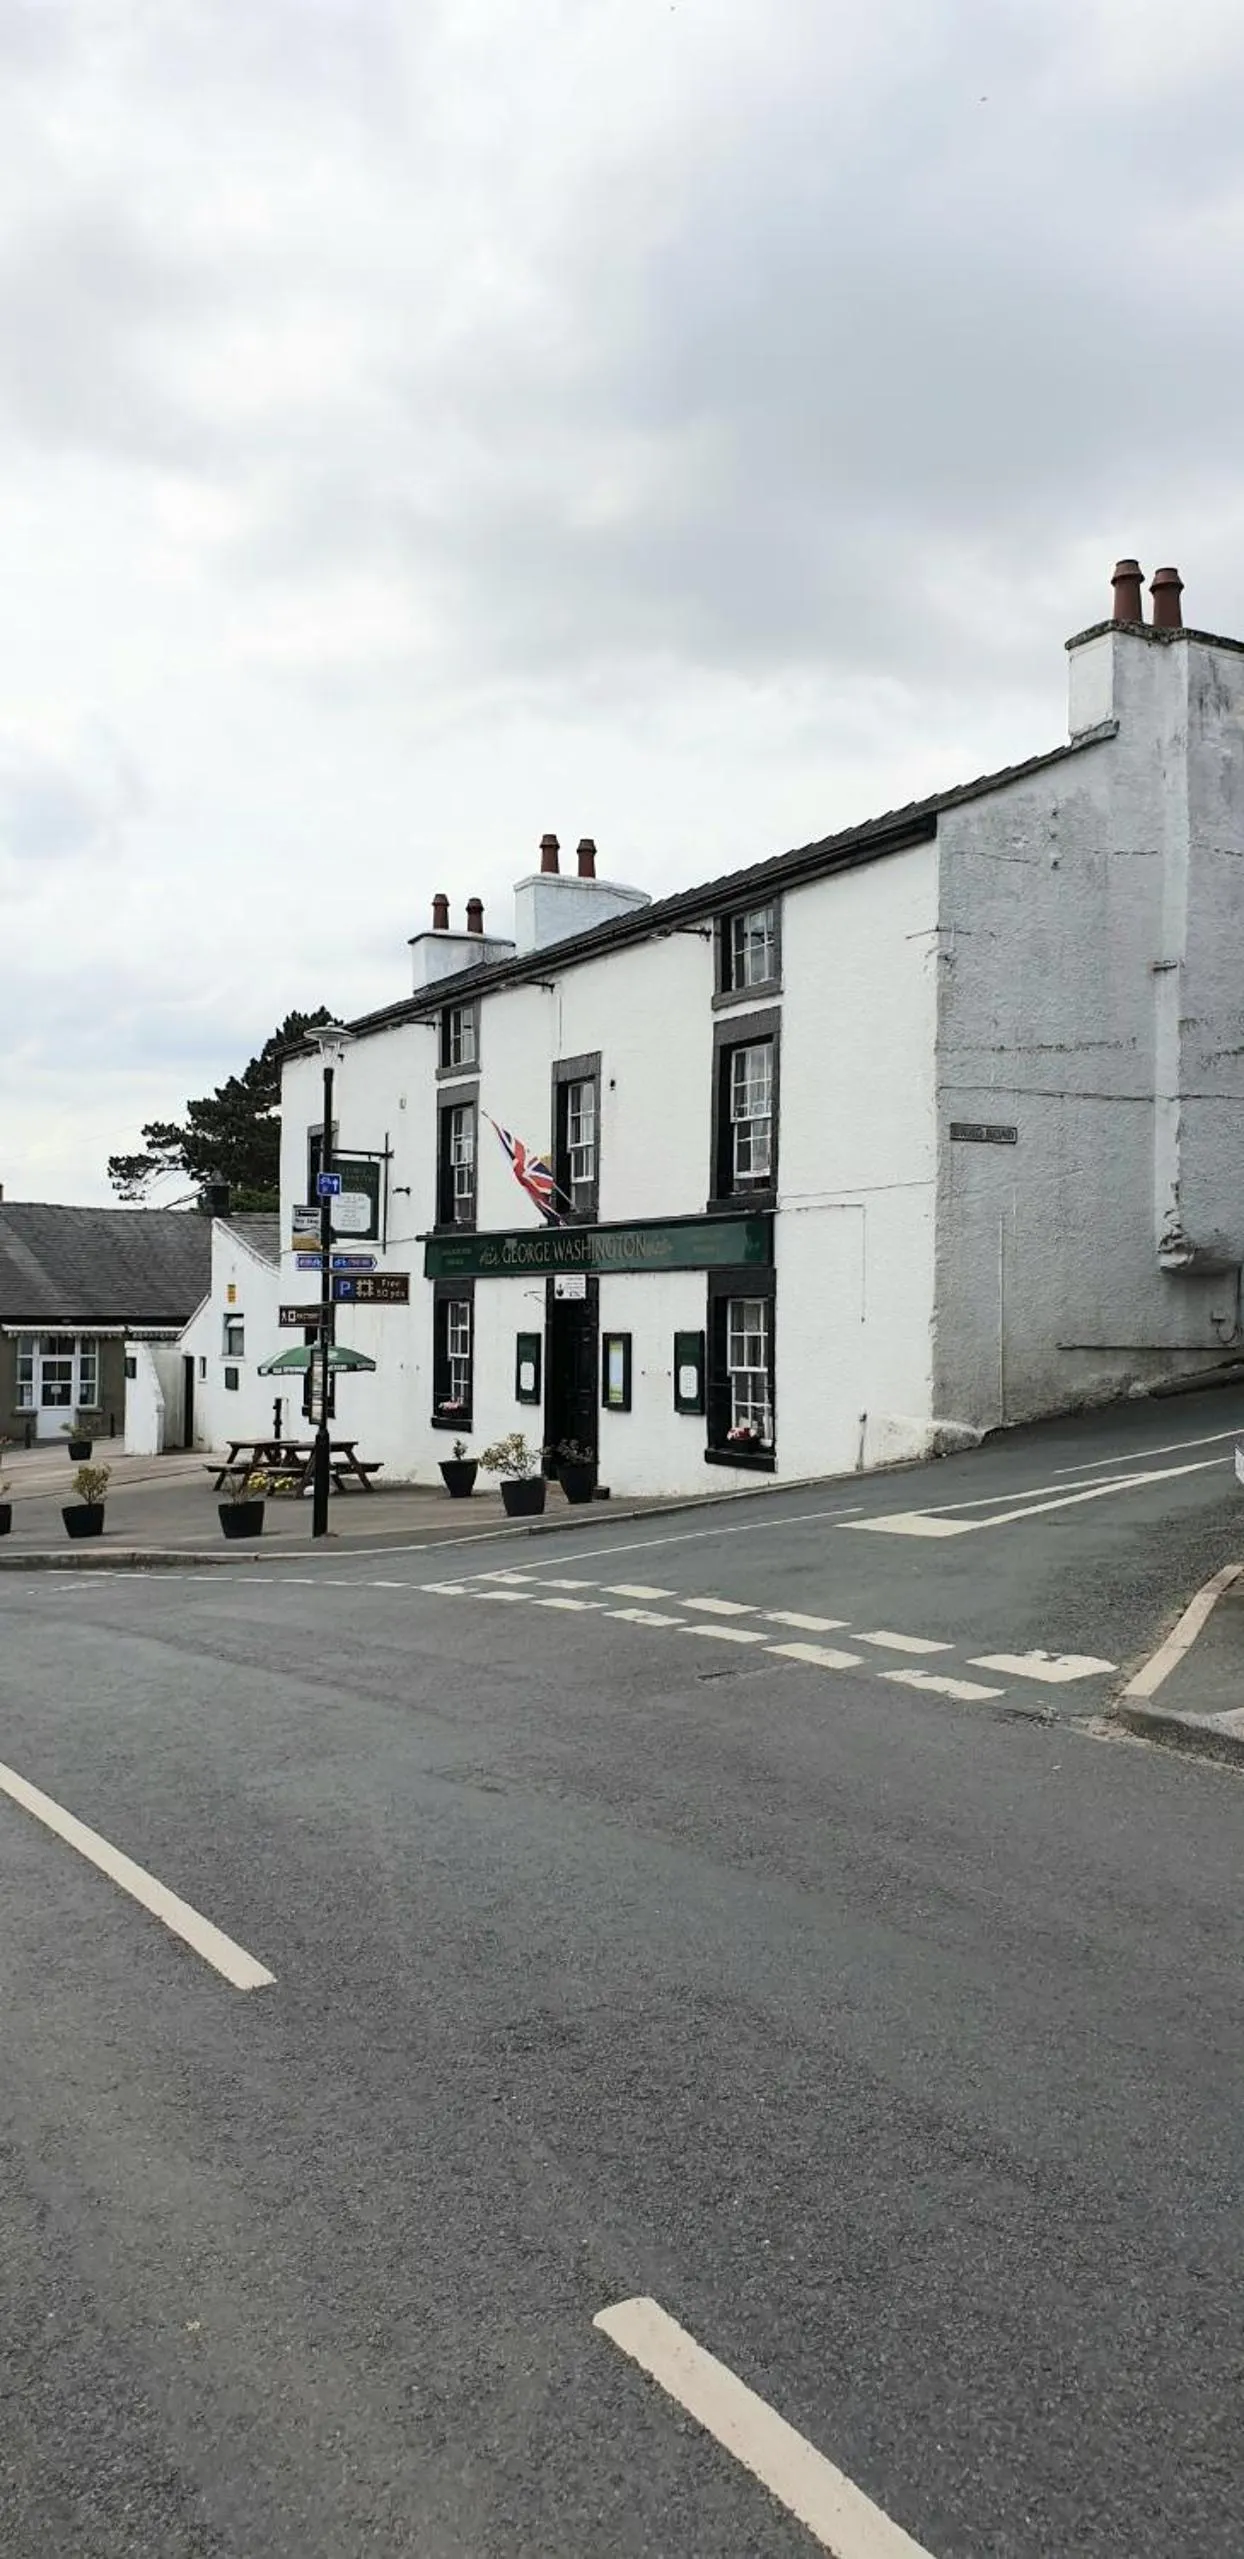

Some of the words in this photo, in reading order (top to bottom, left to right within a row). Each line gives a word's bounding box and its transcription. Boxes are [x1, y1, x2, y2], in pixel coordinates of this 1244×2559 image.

[503, 1241, 550, 1264] GEORGE
[553, 1232, 646, 1262] WASHINGTON
[340, 1281, 351, 1296] P
